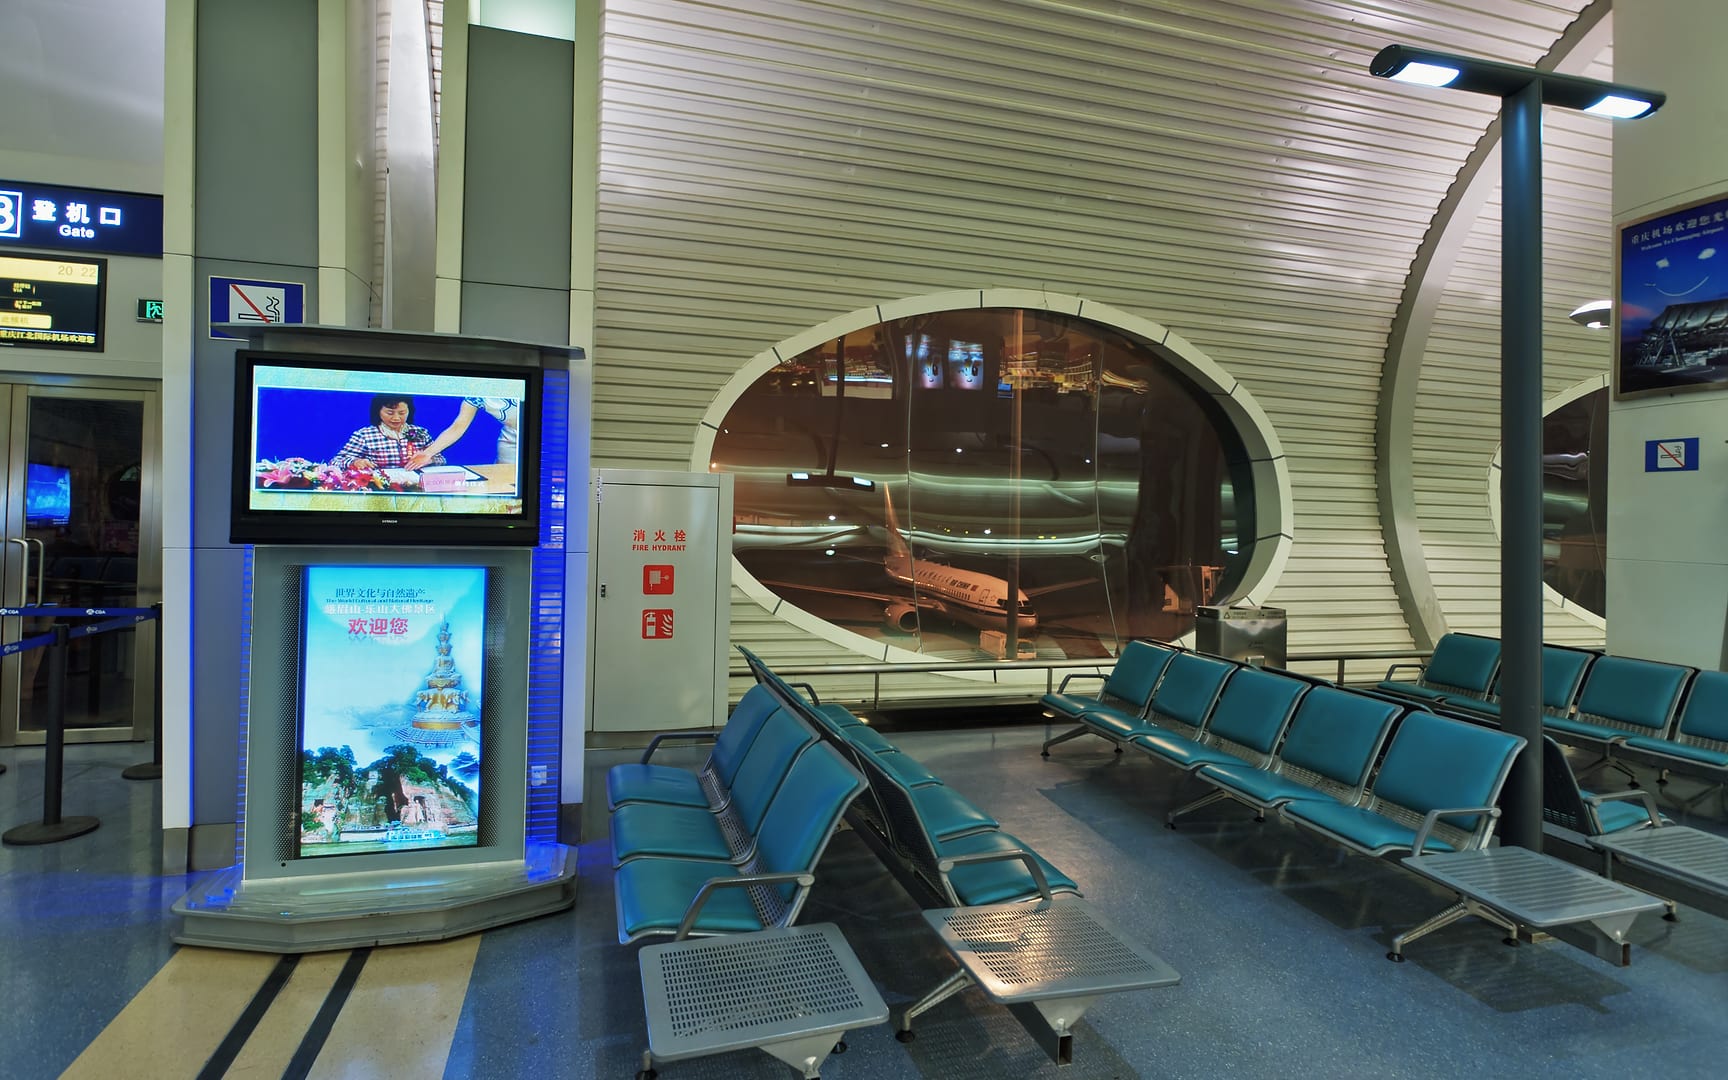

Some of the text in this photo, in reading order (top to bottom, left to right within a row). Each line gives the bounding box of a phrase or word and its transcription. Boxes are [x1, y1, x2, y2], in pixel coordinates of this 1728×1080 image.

[32, 199, 121, 226] 登机口
[59, 225, 95, 239] Gate
[1632, 210, 1728, 245] 重庆机场欢迎您光
[633, 529, 687, 542] 消火栓
[652, 544, 686, 552] HYDRANT
[336, 588, 426, 599] 世界文化与自然遗产
[348, 617, 409, 635] 欢迎您
